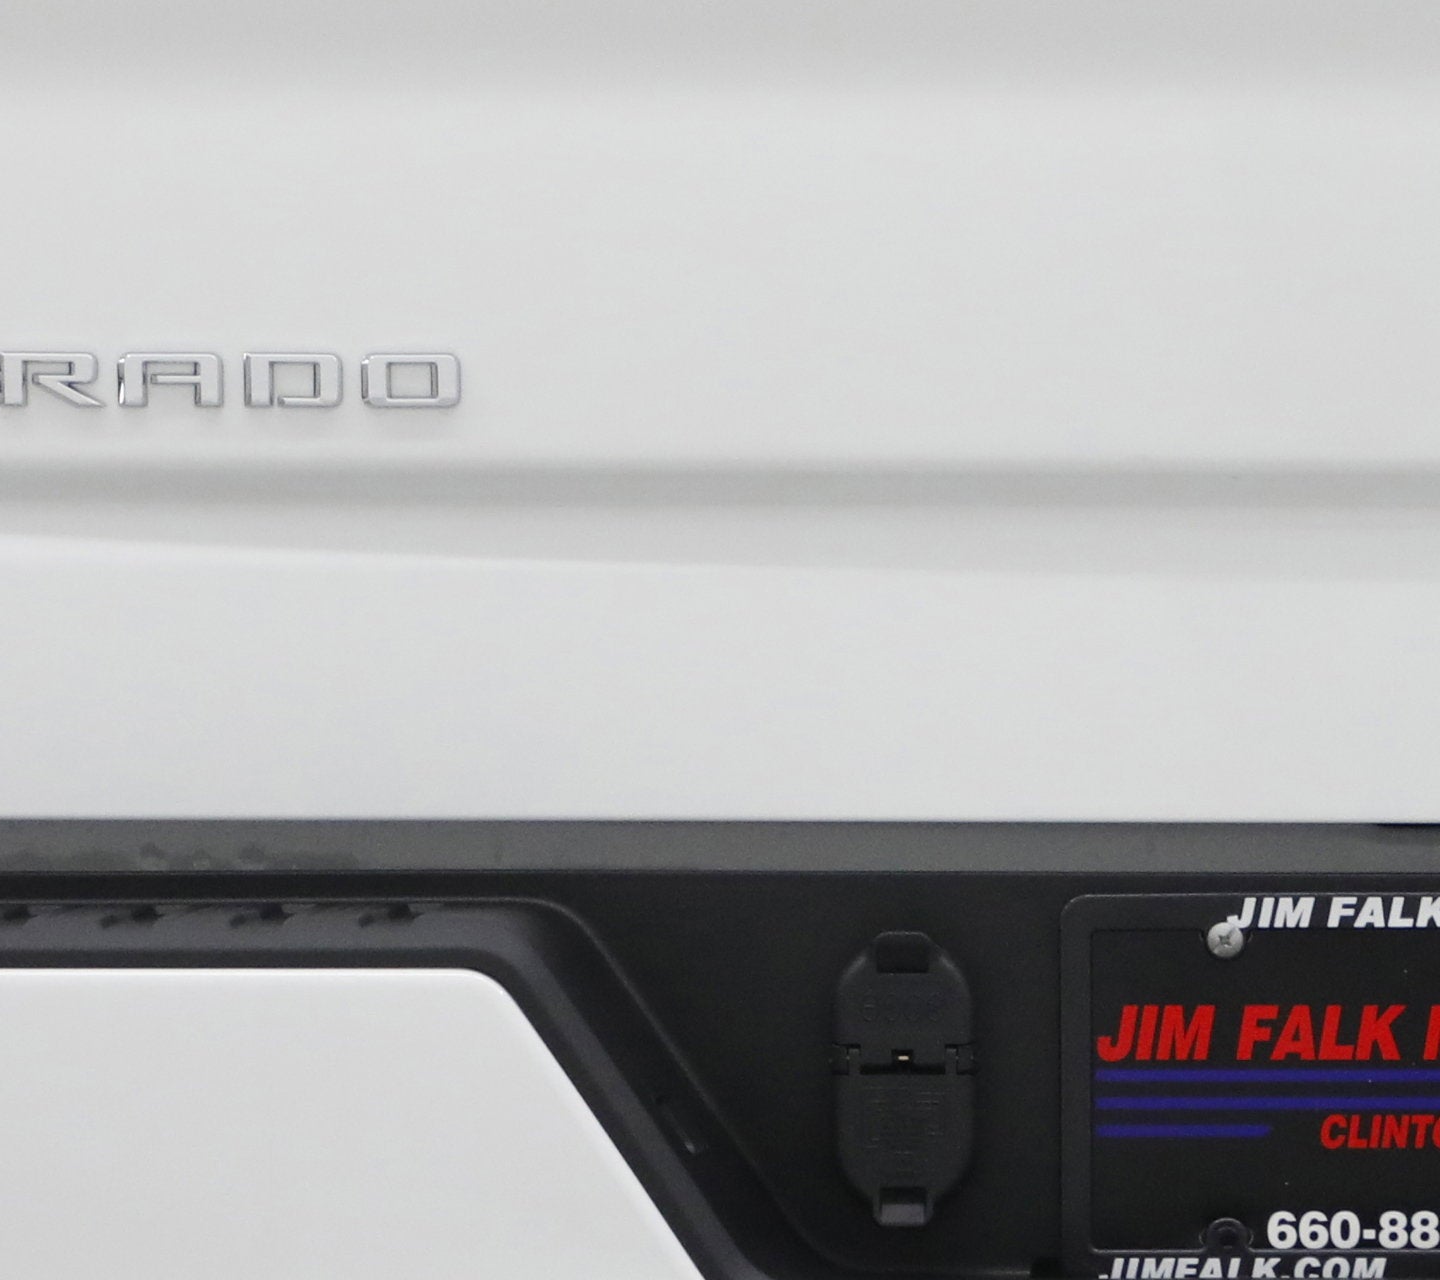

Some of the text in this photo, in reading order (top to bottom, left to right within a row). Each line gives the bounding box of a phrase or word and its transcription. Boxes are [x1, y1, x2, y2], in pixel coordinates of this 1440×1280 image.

[1226, 896, 1316, 929] JIM
[1096, 1004, 1217, 1062] JIM
[1235, 1004, 1407, 1061] FALK
